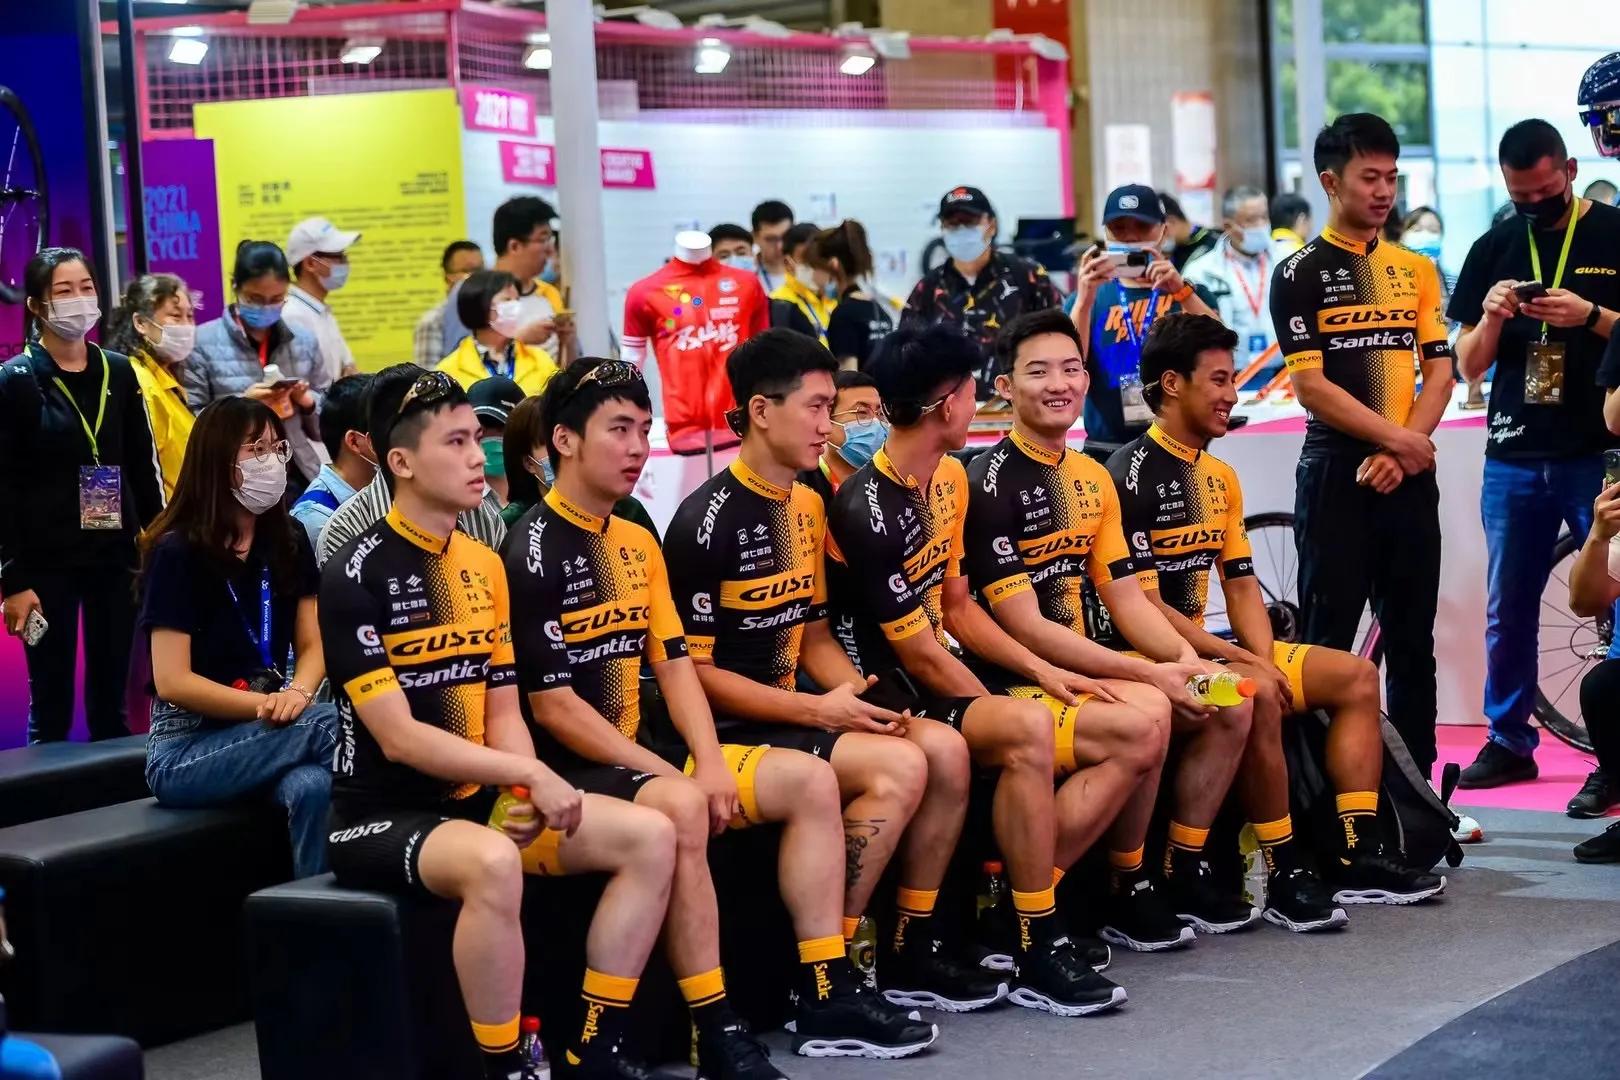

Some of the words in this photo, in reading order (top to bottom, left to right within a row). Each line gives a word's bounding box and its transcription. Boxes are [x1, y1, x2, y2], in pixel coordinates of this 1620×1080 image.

[144, 209, 202, 237] CHINA
[146, 233, 199, 261] CYCLE
[1283, 243, 1316, 282] Santic
[1574, 266, 1617, 276] GUSTO
[1324, 309, 1417, 326] GUSTO
[1328, 331, 1401, 350] Santic
[1023, 442, 1051, 459] GUSTO
[1161, 435, 1188, 454] GUSTO
[983, 448, 1009, 497] Santic
[1126, 446, 1148, 495] Santic
[747, 477, 779, 496] GUSTO
[560, 501, 593, 523] GUSTO
[697, 486, 731, 550] Santic
[869, 477, 887, 536] Santic
[400, 520, 433, 543] GUSTO
[1153, 530, 1226, 549] GUSTO
[345, 532, 383, 583] Santic
[526, 516, 547, 577] Santic
[906, 535, 954, 577] GUST
[1155, 553, 1212, 571] Santic
[739, 574, 815, 602] GUST
[738, 603, 808, 630] Santic
[391, 629, 495, 657] GUSTO
[567, 634, 637, 665] Santic
[398, 659, 481, 688] Santic
[340, 699, 355, 776] Santic
[329, 820, 392, 843] GUSTO
[1343, 817, 1359, 848] Santic
[813, 963, 832, 1000] Santic
[581, 1002, 604, 1043] Santic
